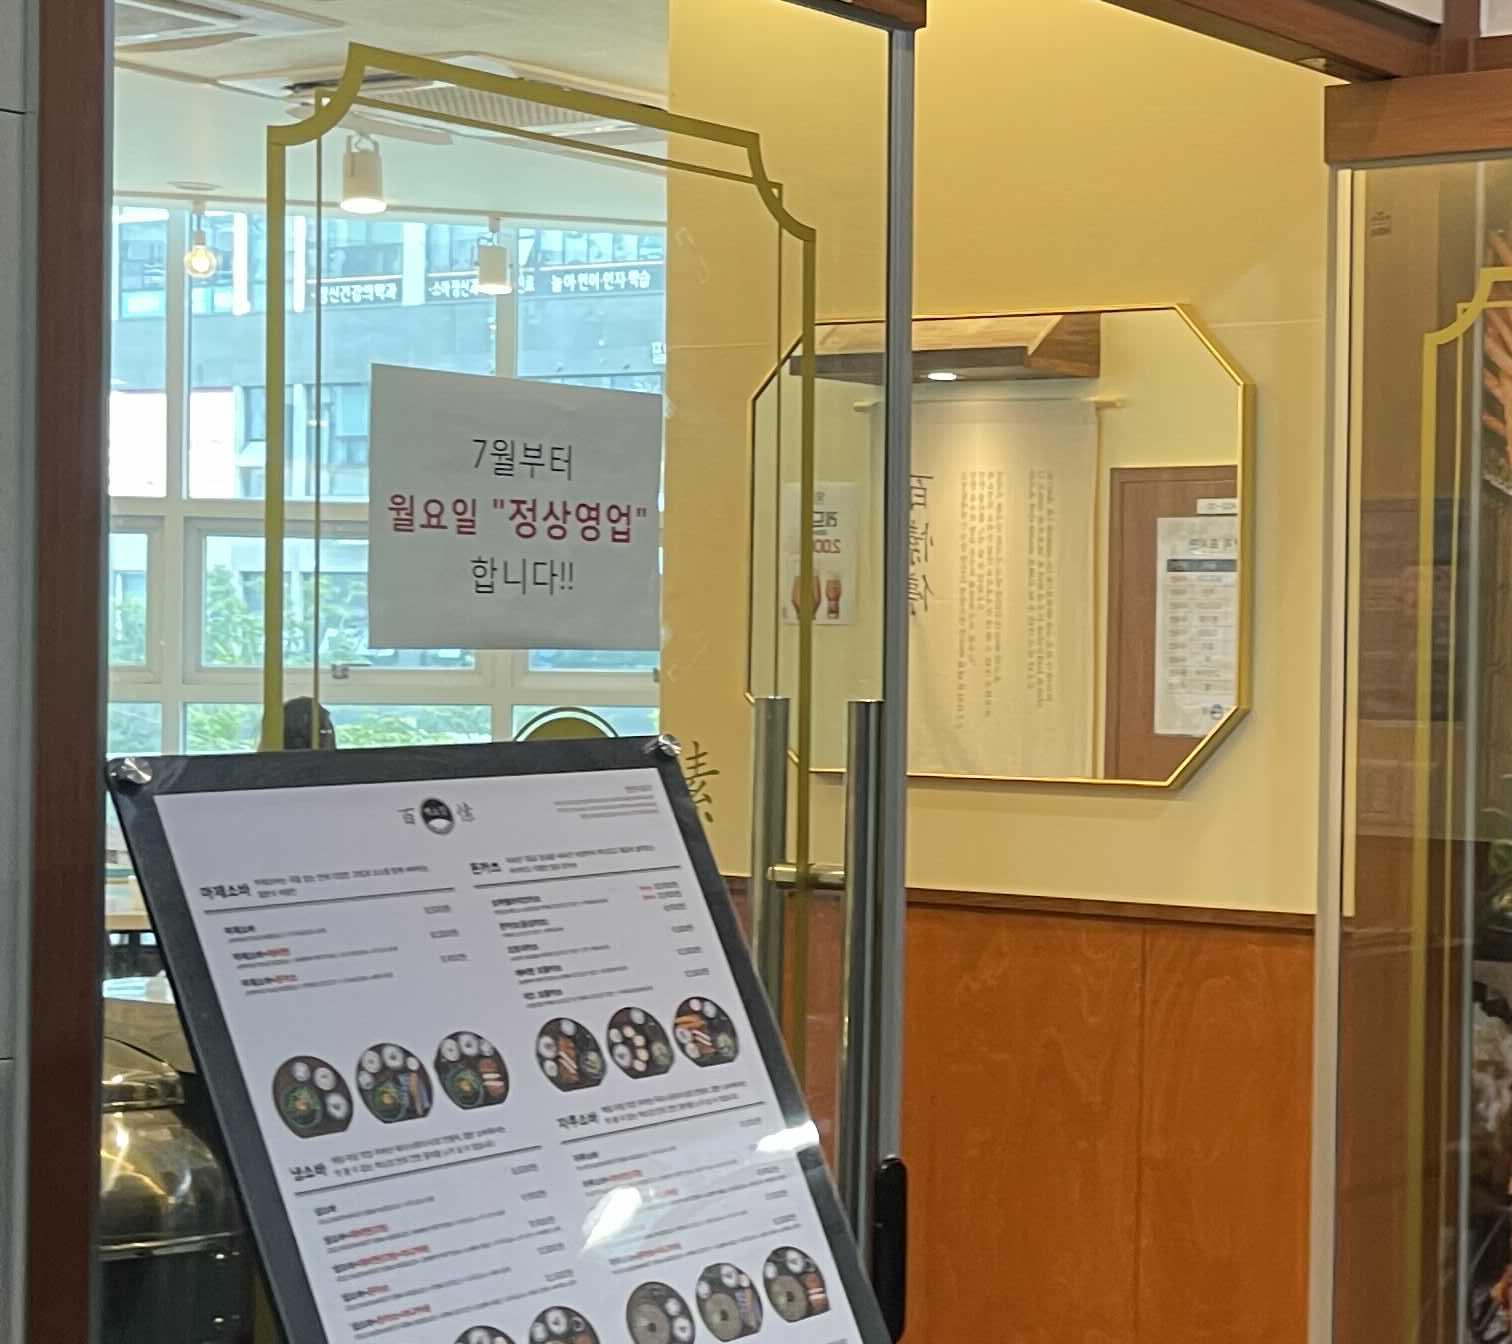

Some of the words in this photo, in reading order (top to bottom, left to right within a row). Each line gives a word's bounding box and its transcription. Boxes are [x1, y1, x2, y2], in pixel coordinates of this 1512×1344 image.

[473, 438, 574, 481] 7월부터
[388, 494, 478, 536] 월요일
[493, 497, 647, 545] "정상영업"
[471, 557, 575, 596] 합니다!!
